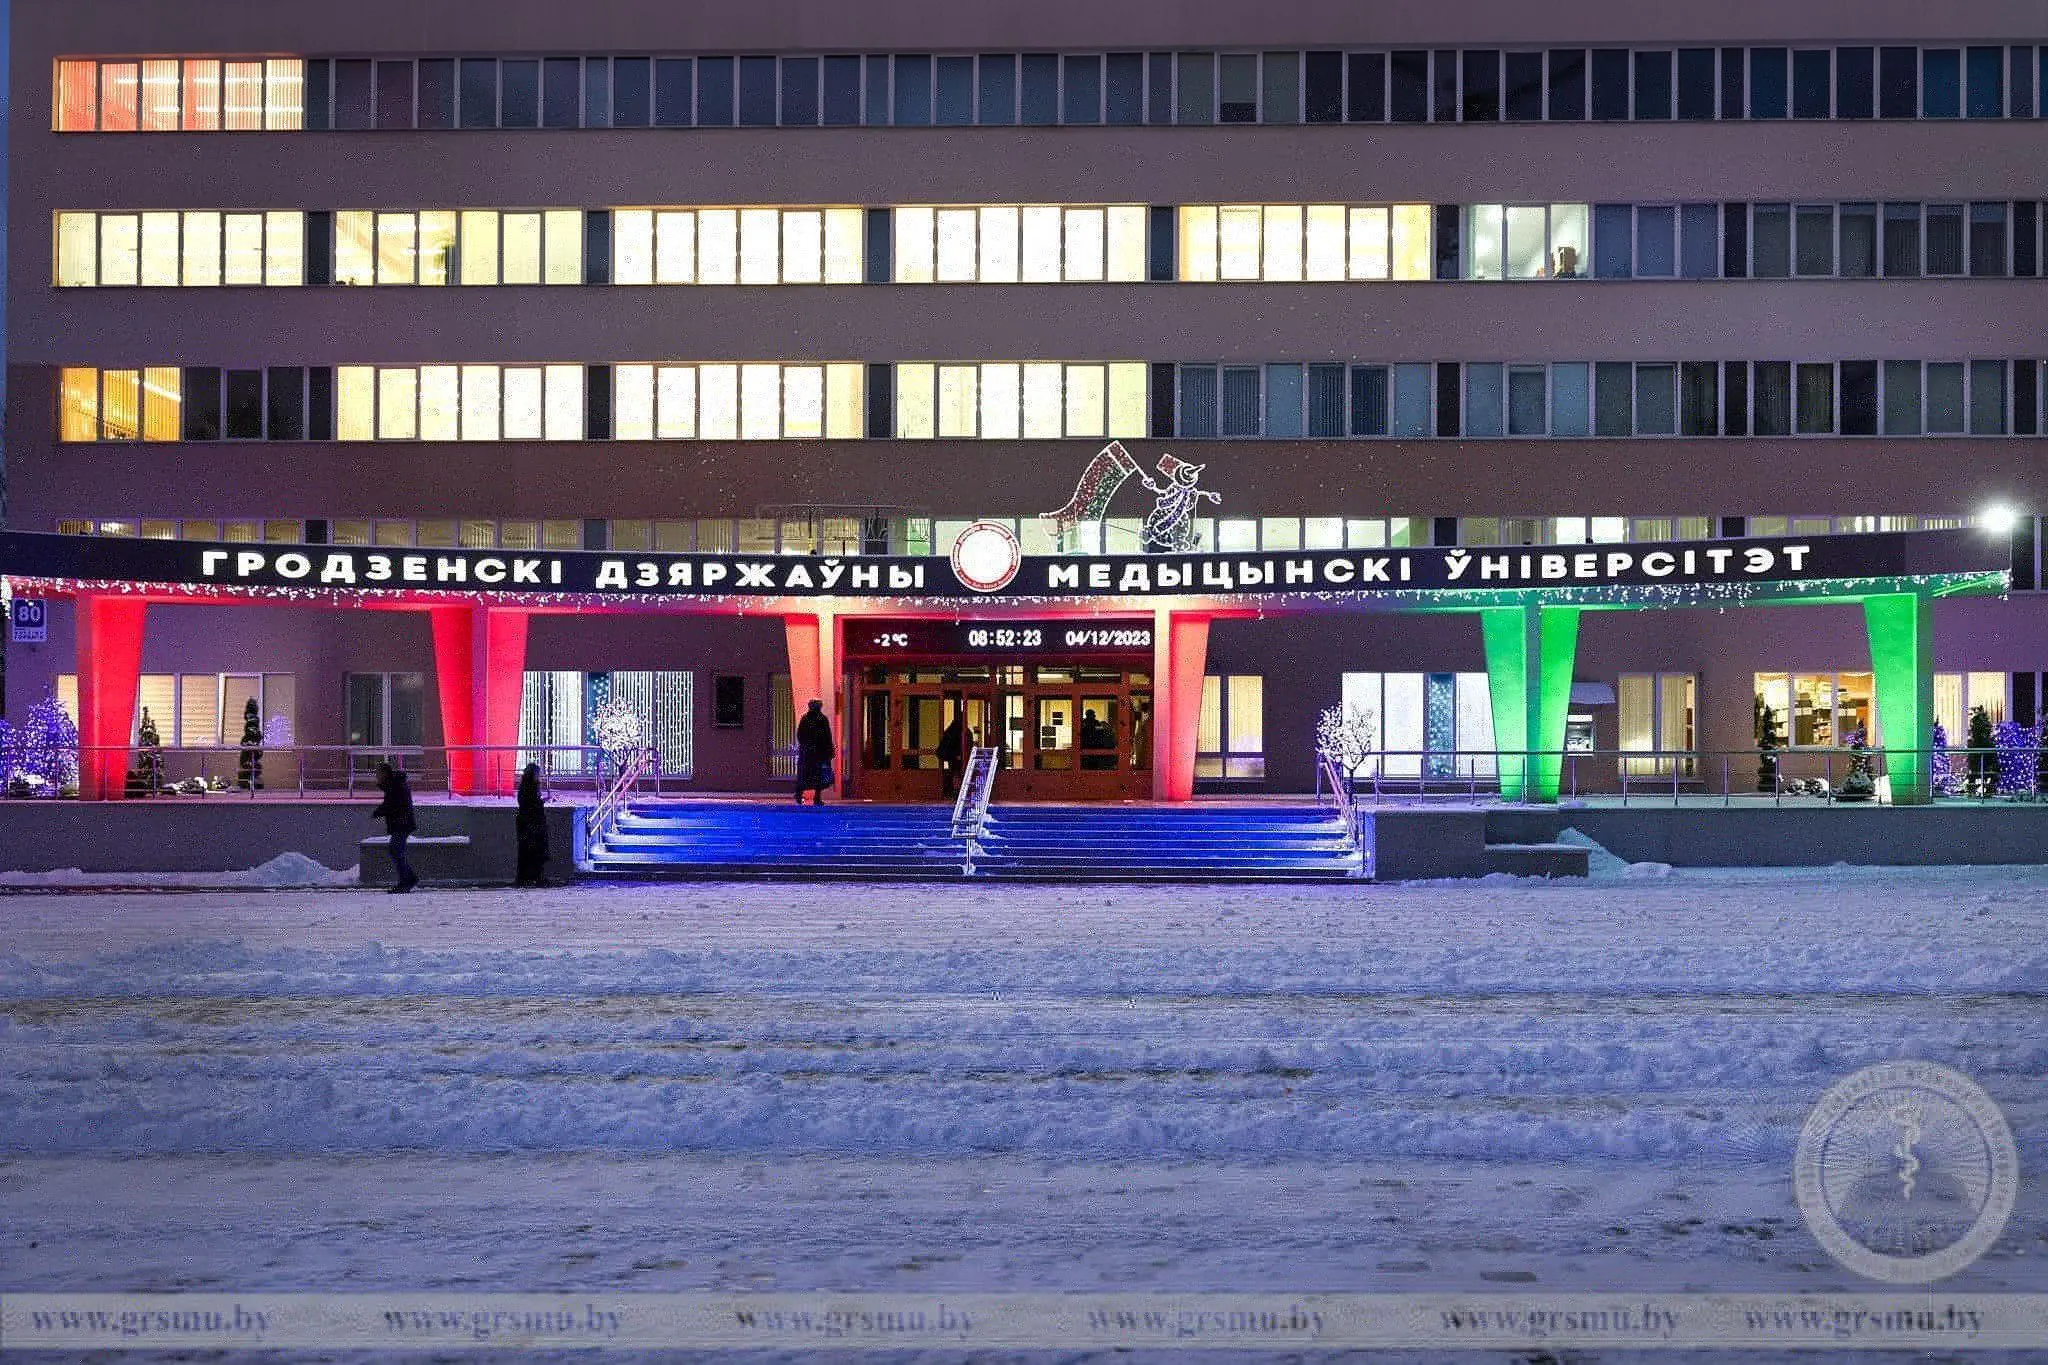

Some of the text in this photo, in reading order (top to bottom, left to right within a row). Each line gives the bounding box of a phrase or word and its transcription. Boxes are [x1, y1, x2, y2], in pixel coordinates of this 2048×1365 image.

[203, 546, 1809, 591] ГРОДЗЕНСКІ ДЗЯРЖАЎНЫ МЕДЫЦЫНСКІ ЎНІВЕРСІТЭТ
[968, 629, 1042, 647] 08:52:23
[1065, 629, 1151, 647] 04/12/2023
